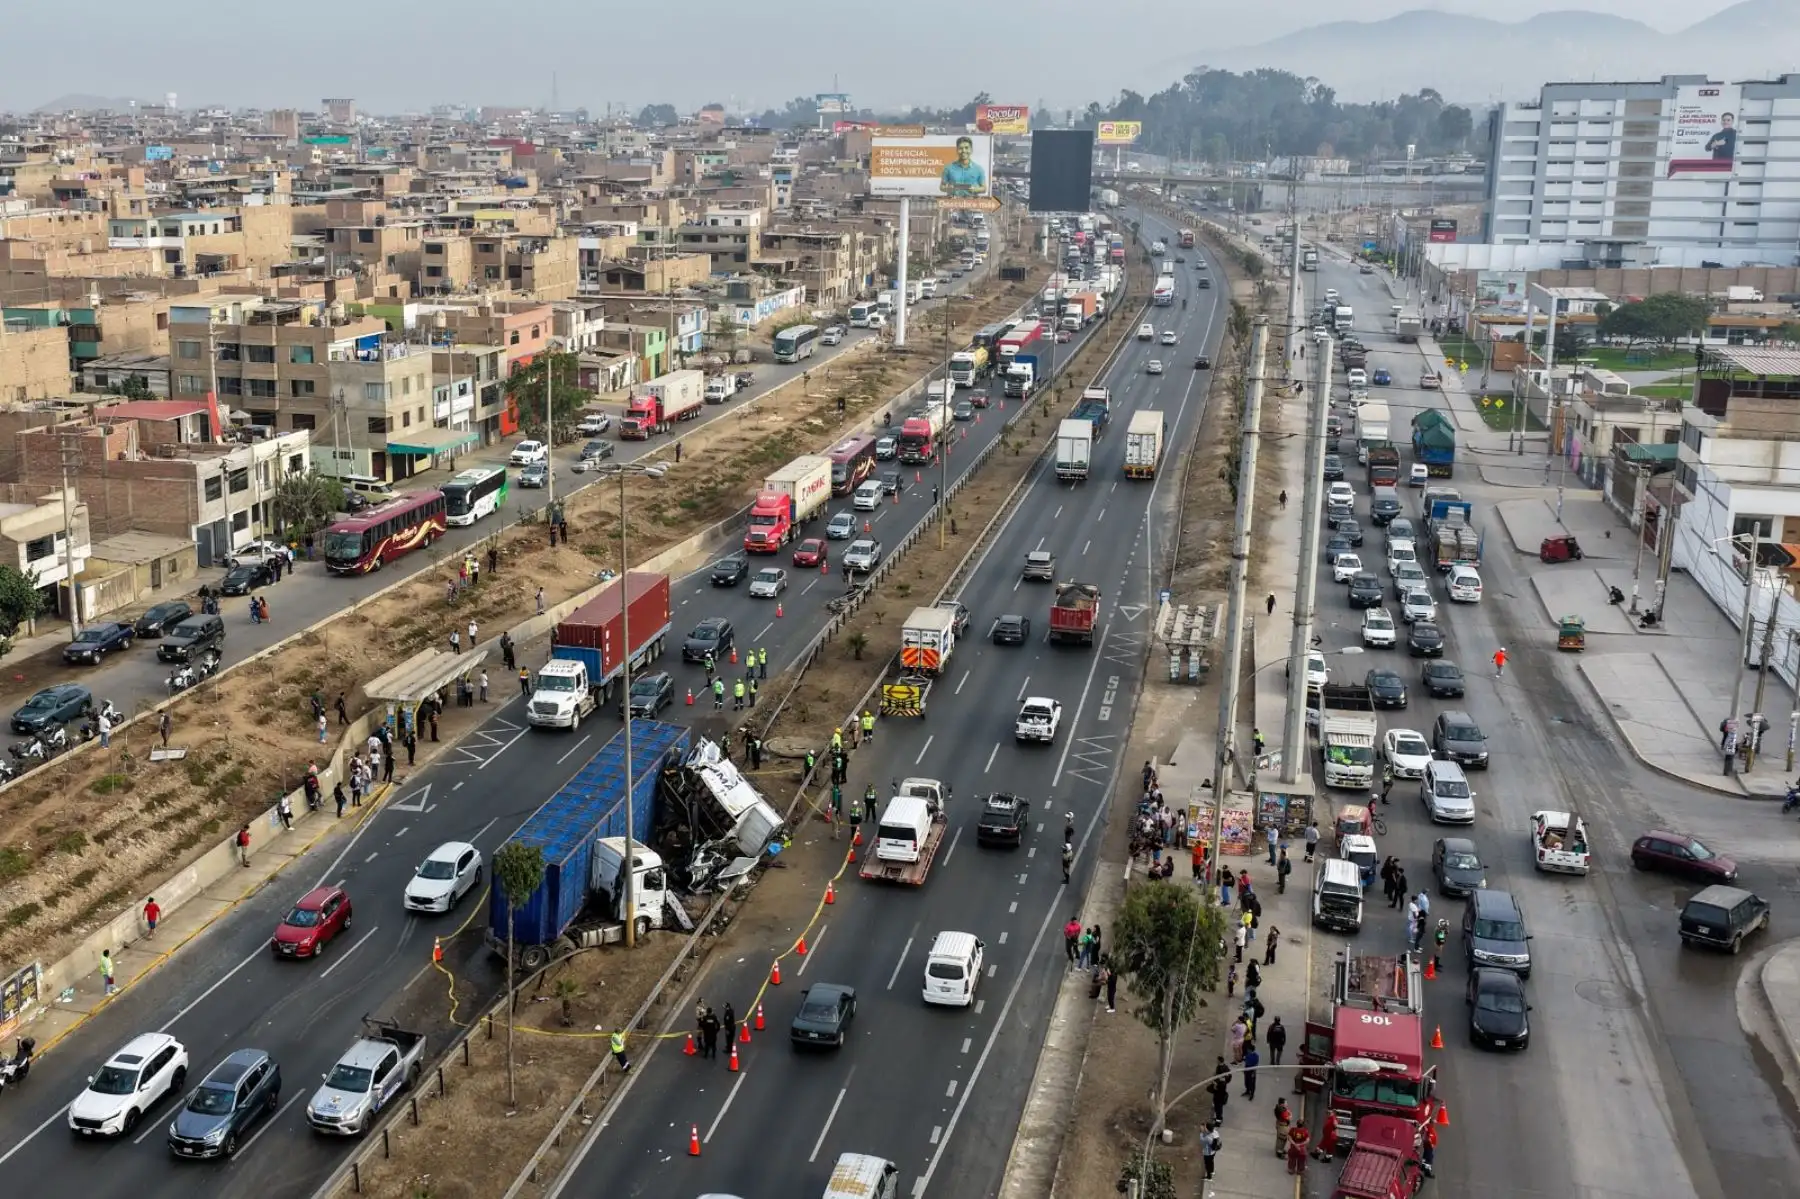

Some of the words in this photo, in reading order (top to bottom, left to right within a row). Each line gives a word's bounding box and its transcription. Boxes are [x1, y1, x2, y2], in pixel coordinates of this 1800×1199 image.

[880, 167, 901, 175] 100%
[938, 199, 977, 208] Descubre
[1098, 675, 1120, 720] BUS
[1361, 1014, 1393, 1026] 106
